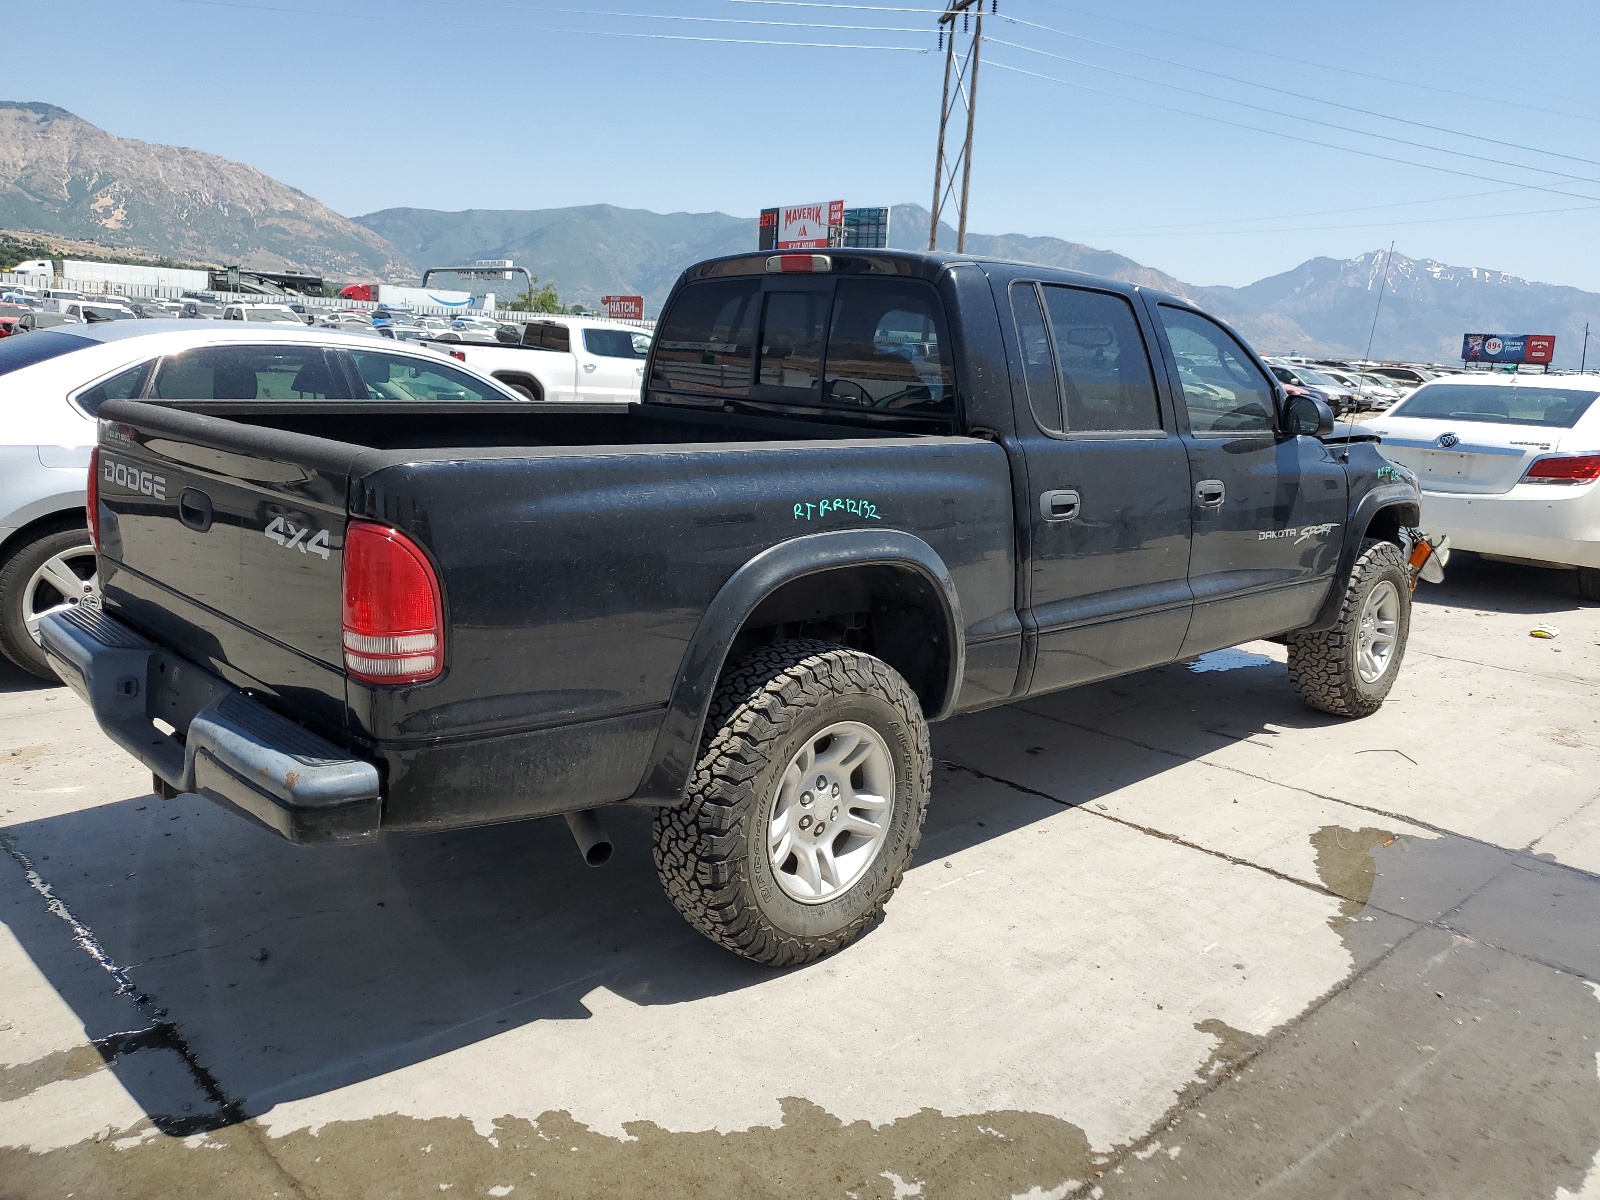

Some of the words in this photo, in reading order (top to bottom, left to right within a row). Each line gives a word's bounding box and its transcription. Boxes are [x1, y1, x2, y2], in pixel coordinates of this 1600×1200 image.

[784, 206, 822, 231] MAVERIK
[611, 302, 635, 313] HATCH
[104, 459, 166, 501] DODGE
[1258, 528, 1297, 541] DAKOTA
[1293, 522, 1341, 546] SPORT
